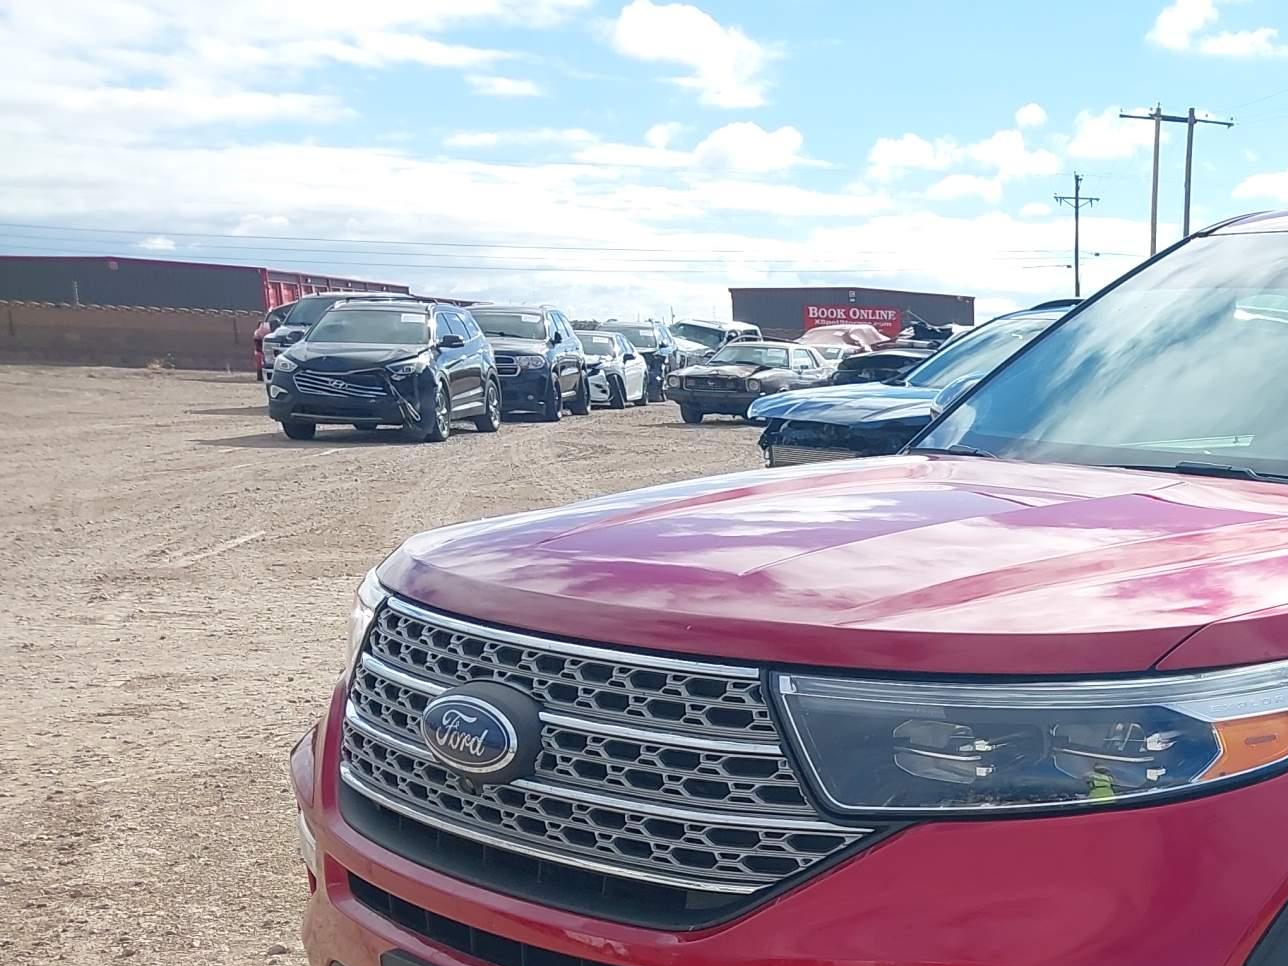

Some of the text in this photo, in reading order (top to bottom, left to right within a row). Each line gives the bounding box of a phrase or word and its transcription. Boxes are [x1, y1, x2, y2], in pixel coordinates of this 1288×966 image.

[808, 306, 897, 321] BOOK ONLINE
[435, 709, 489, 757] Ford
